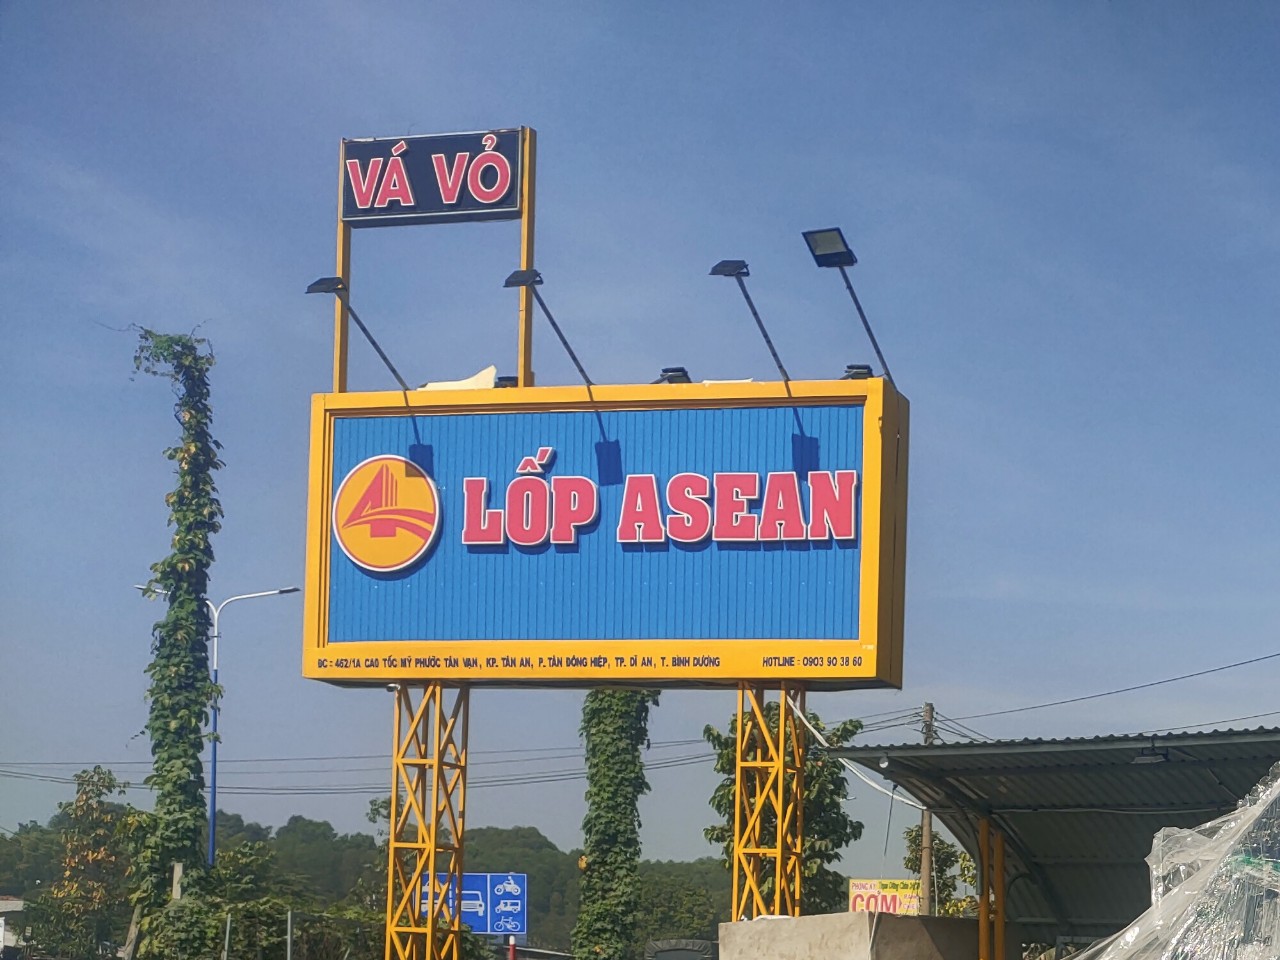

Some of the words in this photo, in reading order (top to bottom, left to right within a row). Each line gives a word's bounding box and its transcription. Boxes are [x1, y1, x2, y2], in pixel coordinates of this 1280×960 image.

[345, 141, 414, 209] VÁ
[432, 134, 512, 206] VỎ
[461, 446, 599, 546] LỐP
[616, 469, 859, 545] ASEAN
[364, 658, 380, 668] CAO
[382, 655, 398, 668] TỐC
[671, 655, 690, 667] BÌNH
[762, 656, 795, 667] HOTLINE
[802, 656, 824, 667] 0903
[826, 656, 838, 667] 90
[839, 656, 850, 667] 38
[852, 656, 863, 667] 60
